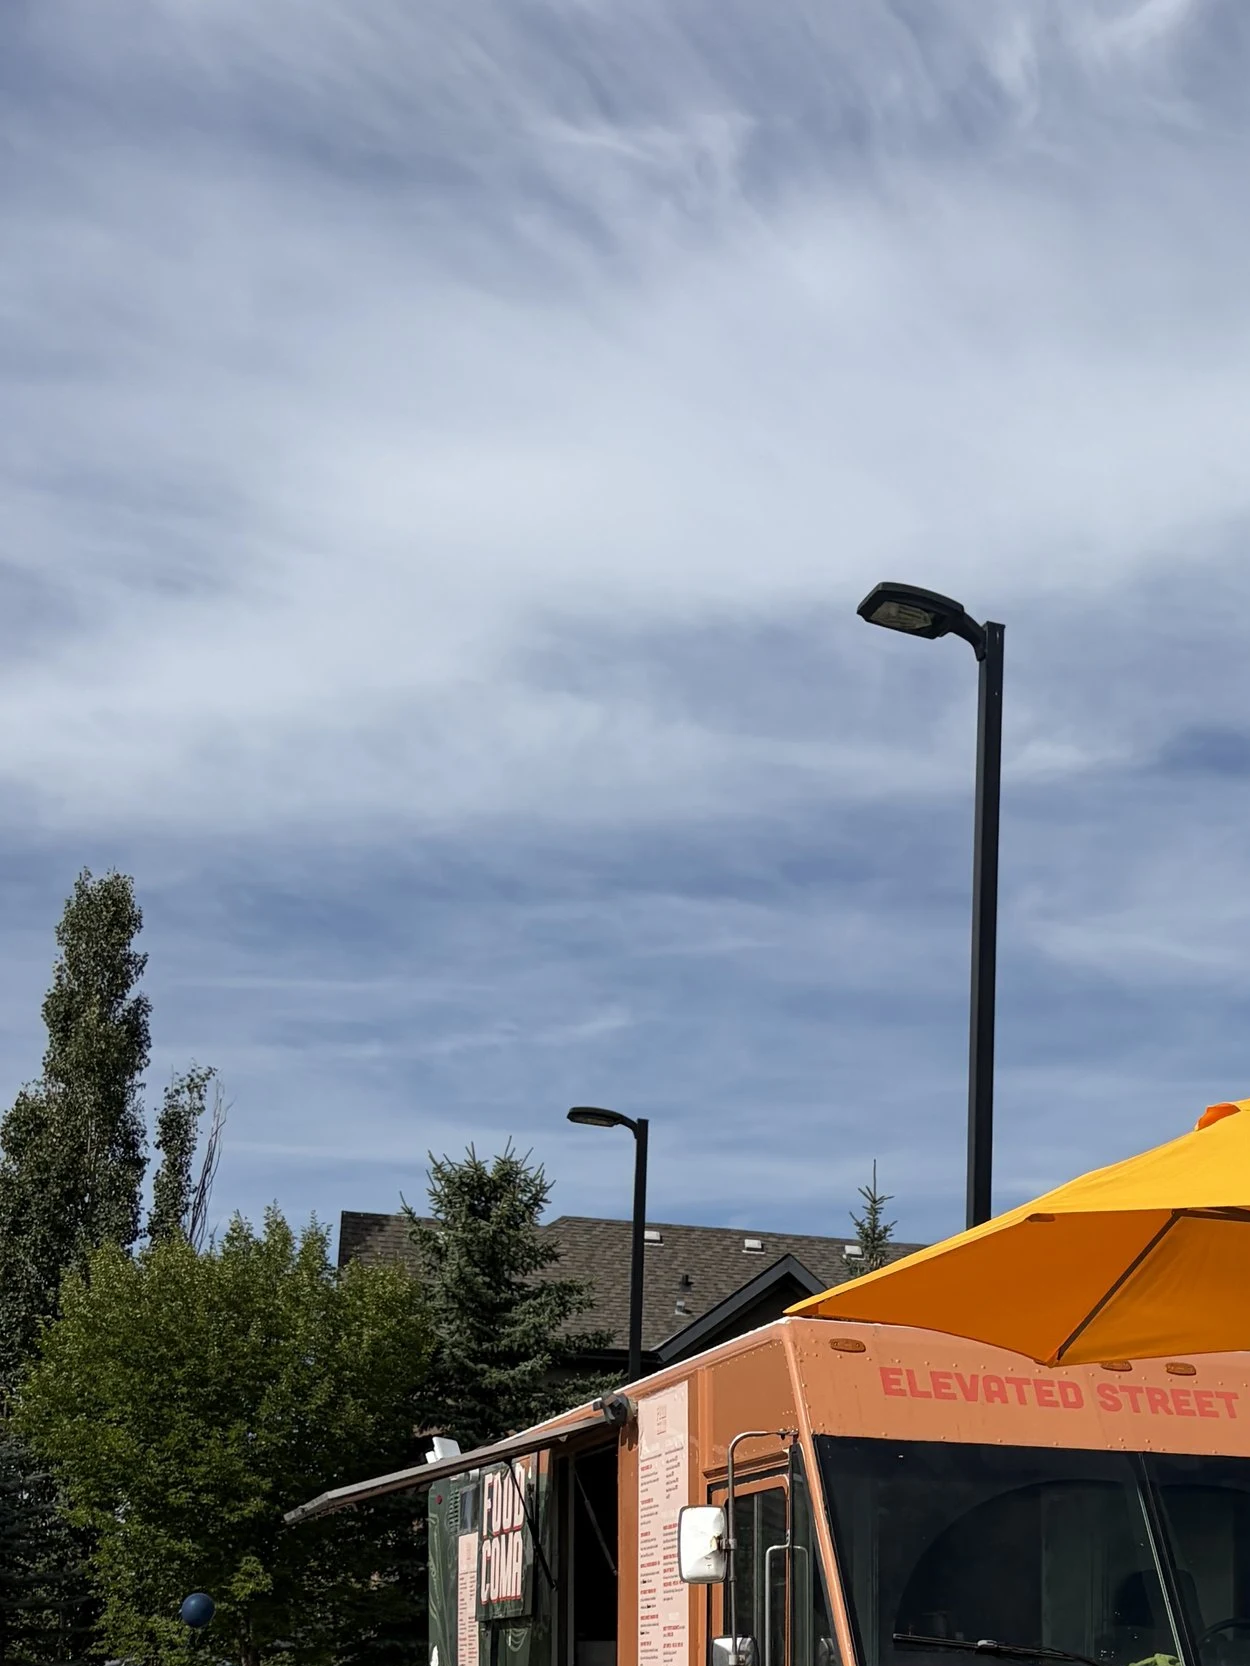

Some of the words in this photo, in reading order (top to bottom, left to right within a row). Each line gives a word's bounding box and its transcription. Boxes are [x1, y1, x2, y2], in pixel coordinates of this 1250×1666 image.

[879, 1366, 1084, 1409] ELEVATED
[1097, 1382, 1239, 1420] STREET
[482, 1463, 526, 1539] FOOD
[480, 1531, 523, 1606] COMA
